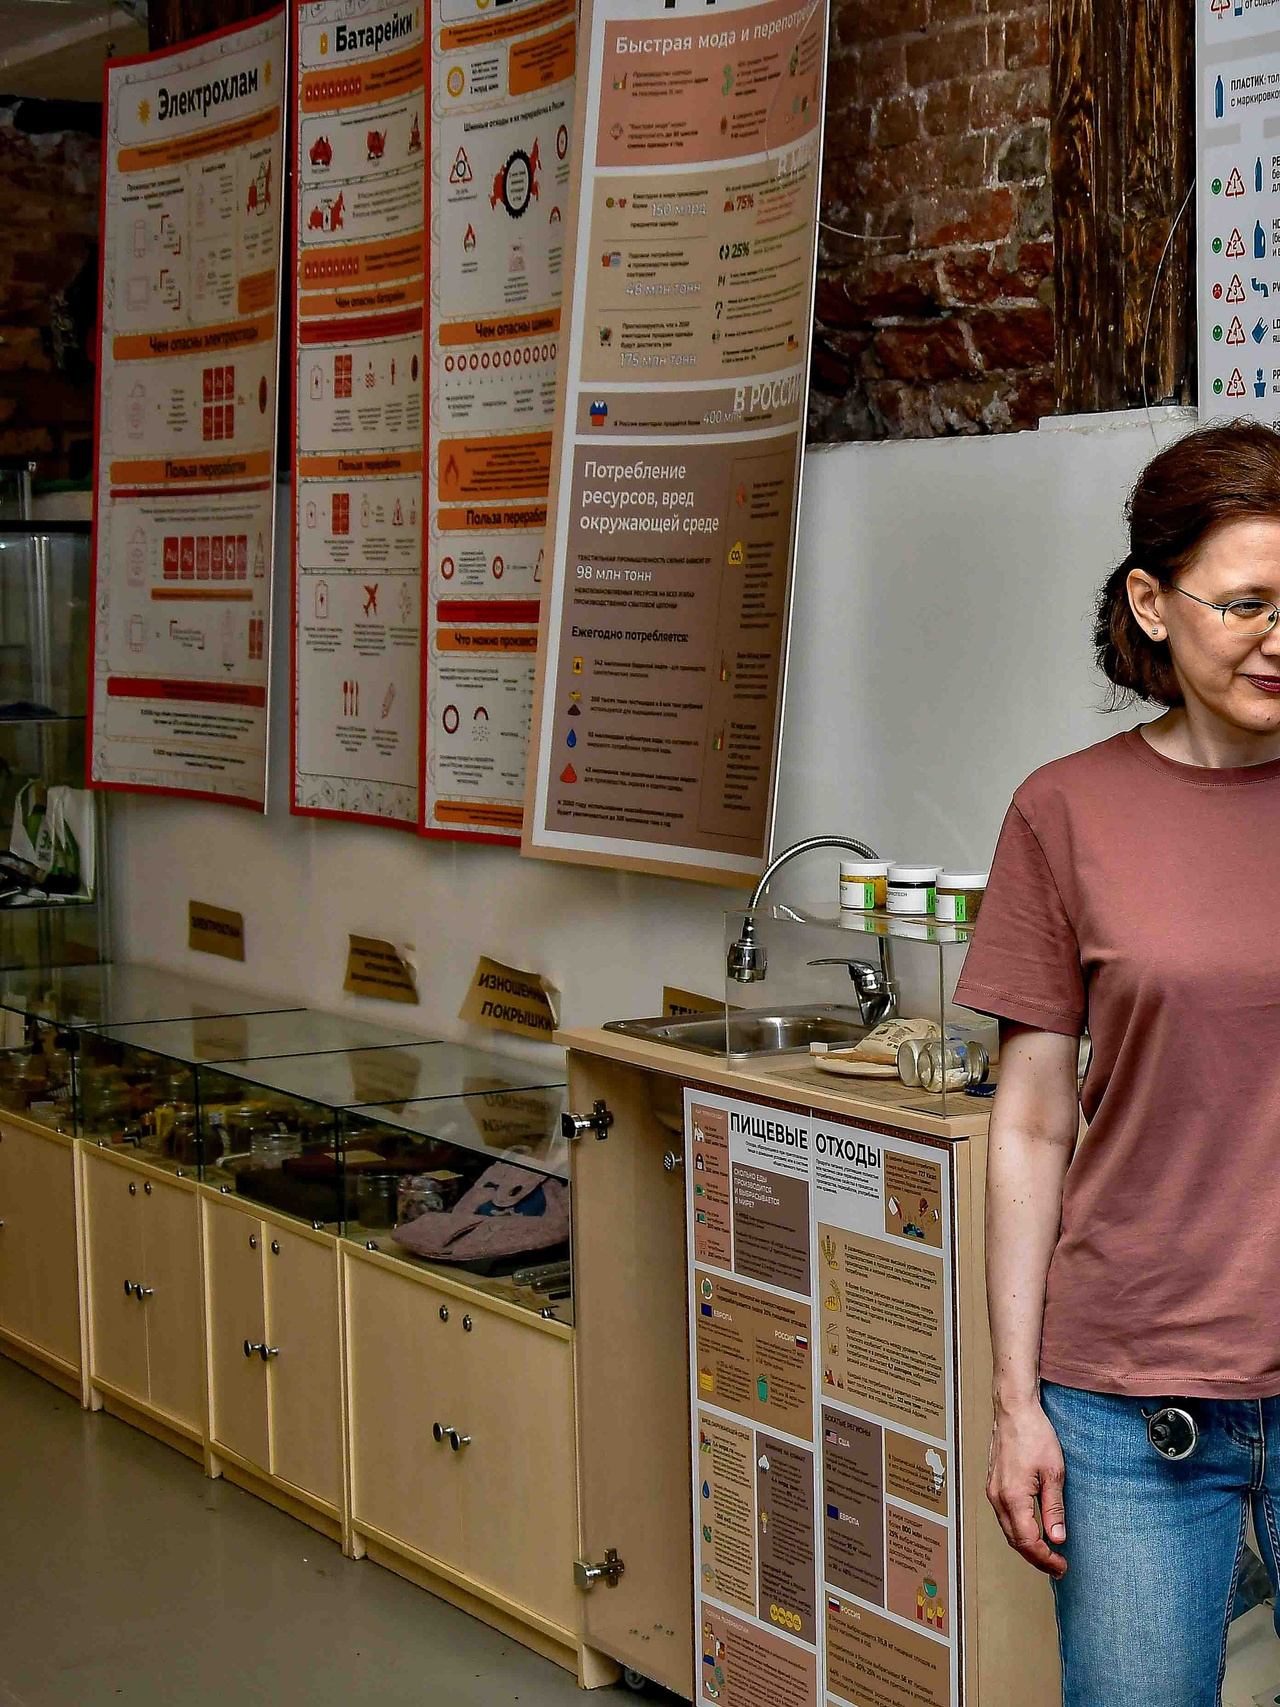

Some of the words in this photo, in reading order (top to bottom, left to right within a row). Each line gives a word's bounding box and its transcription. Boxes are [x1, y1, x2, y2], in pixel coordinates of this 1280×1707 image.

[336, 13, 412, 51] Батарейки
[616, 36, 692, 55] Быстрая
[698, 30, 736, 49] мода
[741, 28, 750, 41] и
[1231, 75, 1266, 91] ПЛАСТИК:
[158, 68, 258, 120] Электрохлам
[1231, 98, 1235, 107] с
[731, 243, 750, 259] 25%
[1272, 248, 1277, 257] и
[475, 324, 495, 338] Чем
[703, 411, 722, 424] 400
[584, 460, 687, 482] Потребление
[582, 490, 658, 509] ресурсов,
[662, 489, 694, 508] вред
[466, 510, 501, 525] Польза
[580, 513, 680, 535] окружающей
[682, 515, 720, 535] среде
[576, 565, 593, 579] 98
[595, 569, 621, 581] млн
[624, 570, 652, 582] тонн
[572, 625, 623, 640] Ежегодно
[624, 630, 689, 643] потребляется:
[481, 1002, 553, 1030] ПОКРЫШКИ
[730, 1112, 809, 1150] ПИЩЕВЫЕ
[815, 1133, 881, 1169] ОТХОДЫ
